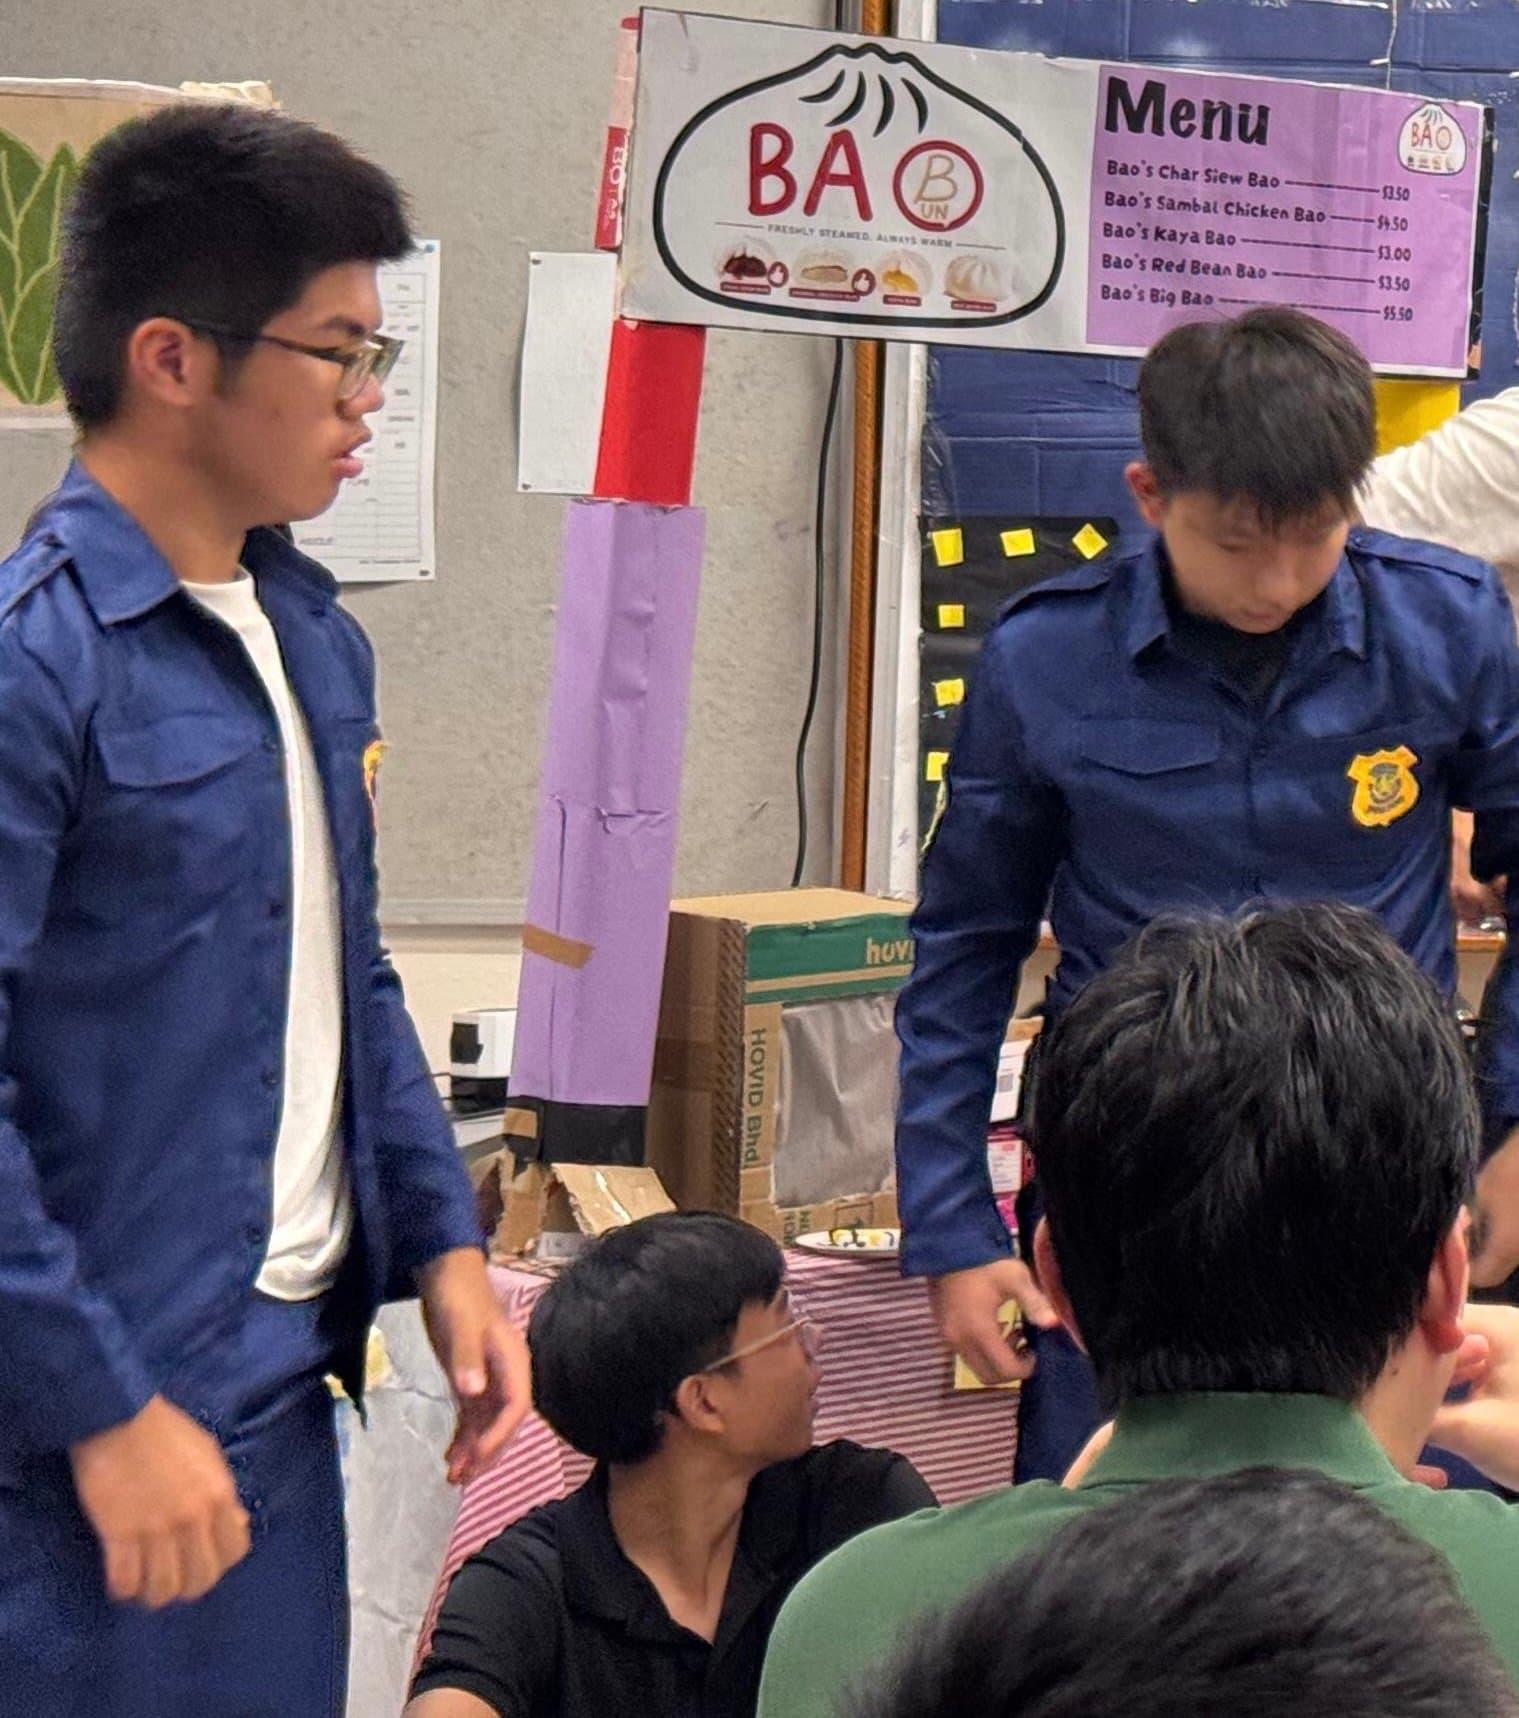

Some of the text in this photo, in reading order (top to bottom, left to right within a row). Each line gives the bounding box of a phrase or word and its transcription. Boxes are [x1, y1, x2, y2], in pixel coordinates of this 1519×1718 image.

[1105, 76, 1270, 145] Menu
[1411, 122, 1452, 151] BAO
[1107, 159, 1410, 202] Bao's Char Siew Bao $3.50
[1104, 191, 1409, 231] Bao's Sambal Chicken Bao $4.50
[767, 223, 814, 237] FRESHLY
[876, 234, 917, 246] ALWAYS
[921, 238, 953, 248] WARM
[1103, 221, 1149, 240] Bao's
[1205, 230, 1237, 246] Bao
[1378, 245, 1411, 262] $3.00
[1102, 252, 1410, 291] Bao's Red Bean Bao $3.50
[1101, 283, 1413, 321] Bao's Big Bao $5.50
[748, 1028, 767, 1107] HOVID
